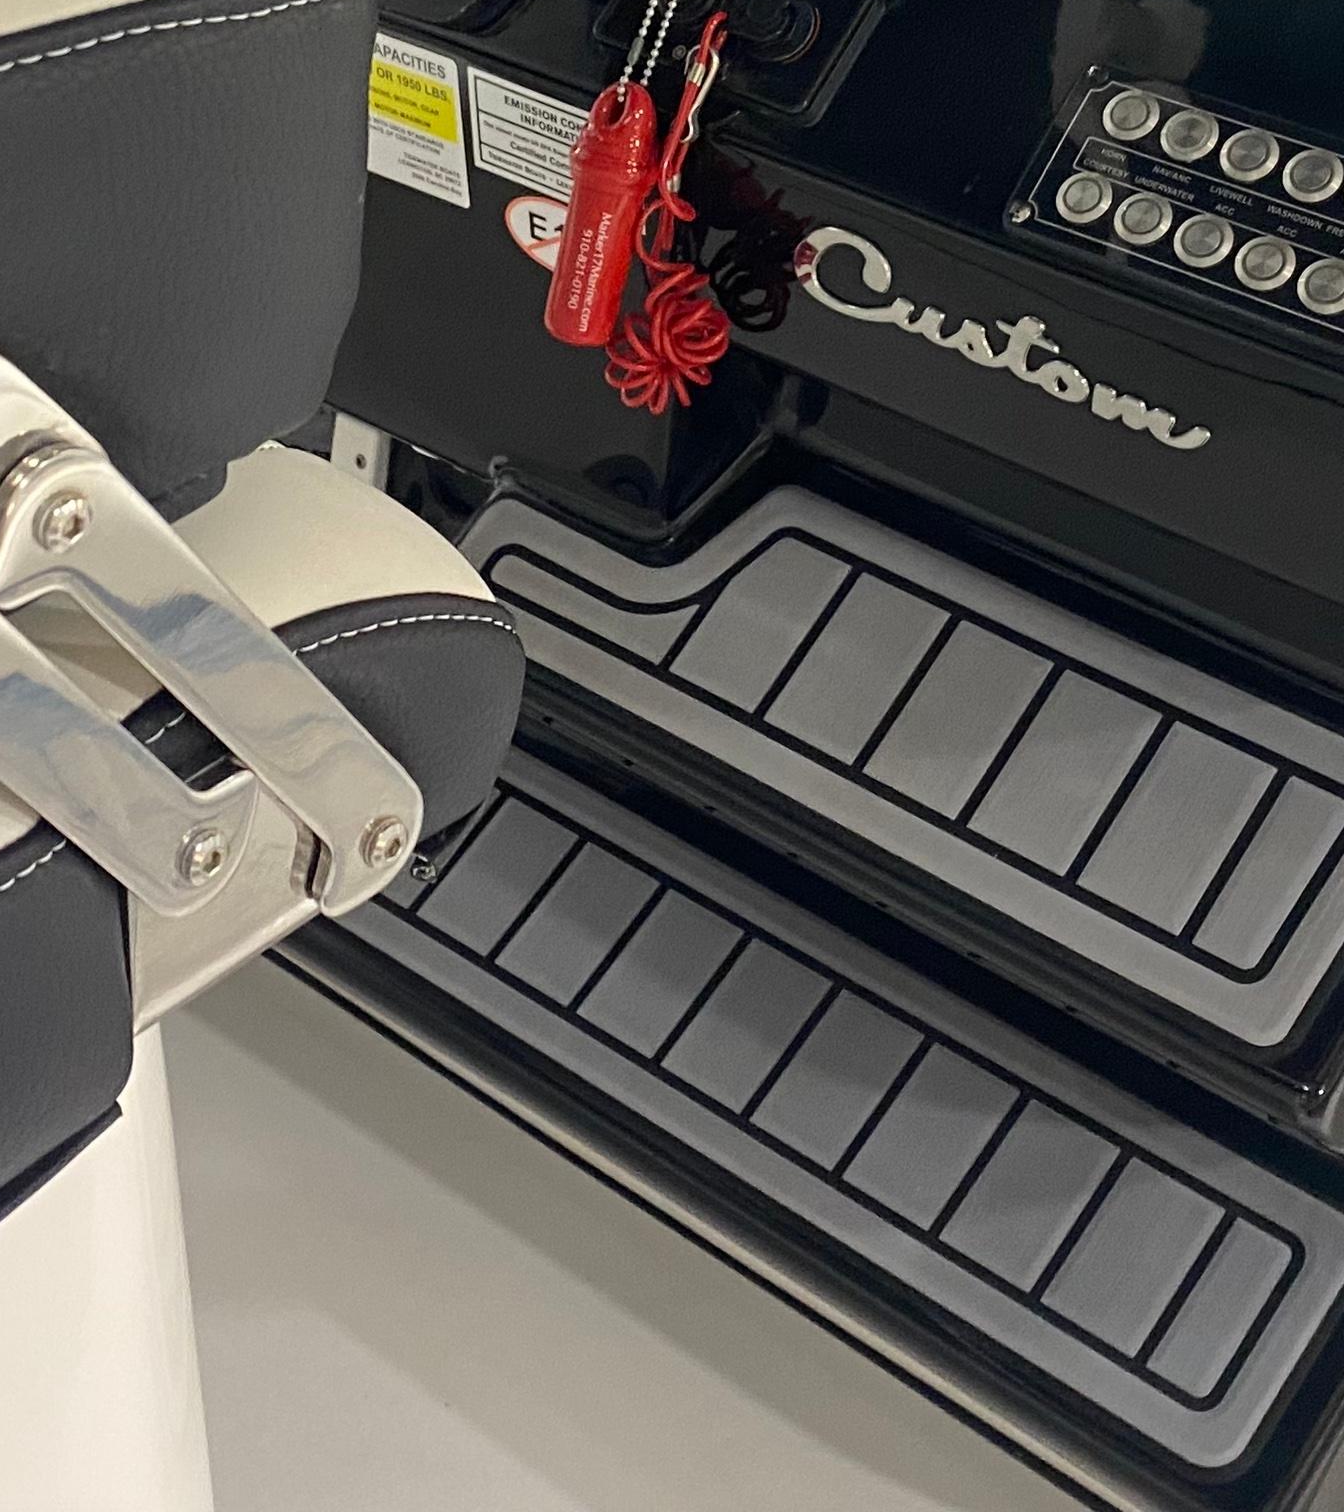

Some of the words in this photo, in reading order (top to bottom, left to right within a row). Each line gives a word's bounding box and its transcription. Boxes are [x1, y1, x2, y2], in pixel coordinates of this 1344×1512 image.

[373, 42, 447, 79] APACITIES
[376, 67, 394, 82] OR
[397, 74, 422, 93] 1950
[504, 95, 558, 123] EMISSION
[520, 113, 577, 142] INFORMAT
[1101, 148, 1127, 162] HORN
[1083, 159, 1130, 178] COURTESY
[1134, 175, 1196, 203] UNDERWATER
[1209, 185, 1254, 207] LIVEWELL
[1215, 203, 1236, 217] ACC
[1267, 205, 1323, 230] WASHDOWN
[1276, 225, 1298, 238] ACC
[794, 226, 1212, 450] Custom
